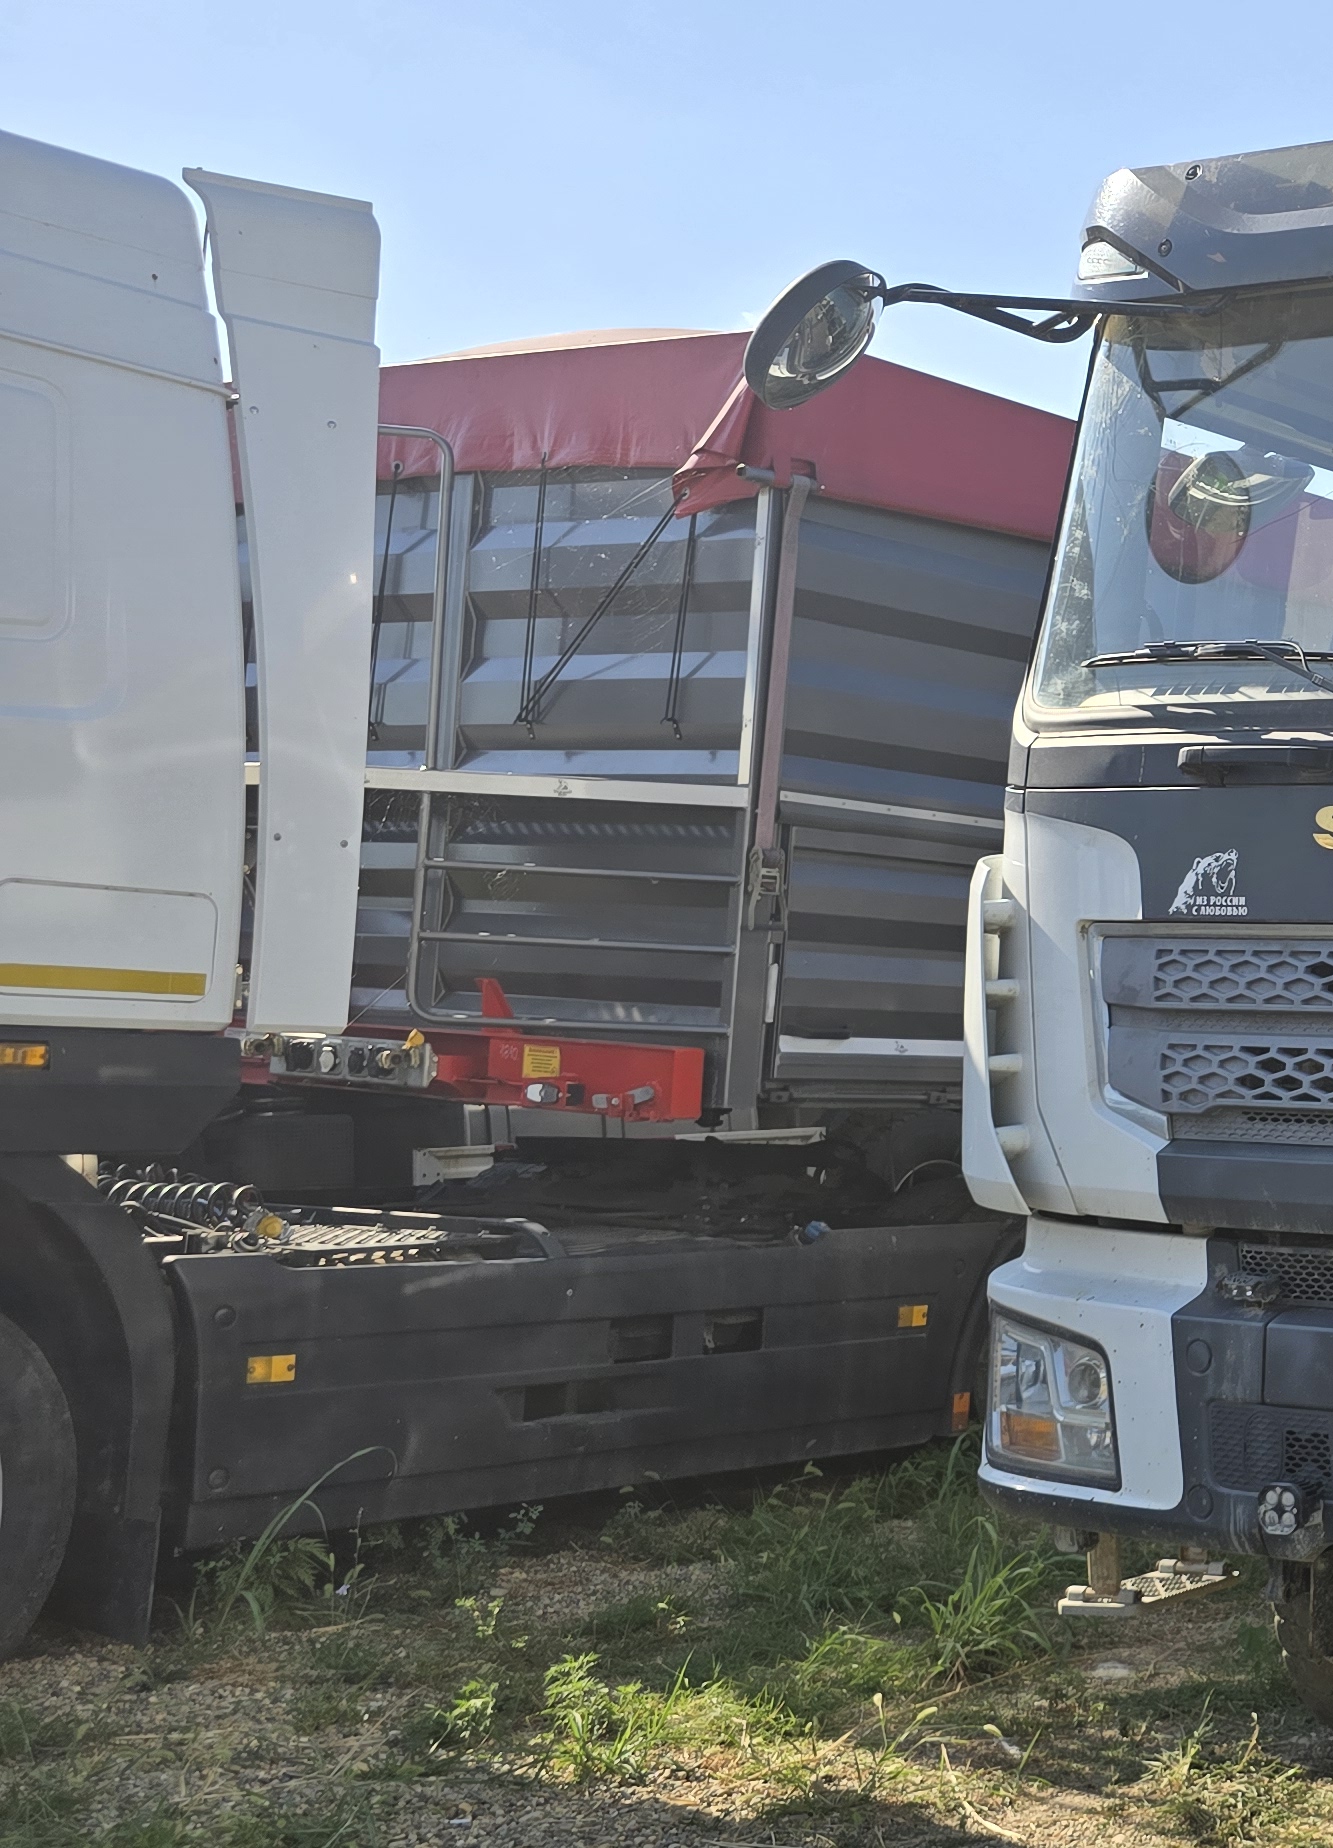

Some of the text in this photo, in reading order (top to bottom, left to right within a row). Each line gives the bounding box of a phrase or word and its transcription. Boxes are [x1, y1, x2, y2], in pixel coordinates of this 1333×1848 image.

[1195, 896, 1246, 906] ИЗ РОССИИ
[1192, 906, 1248, 916] С ЛЮБОВЬЮ
